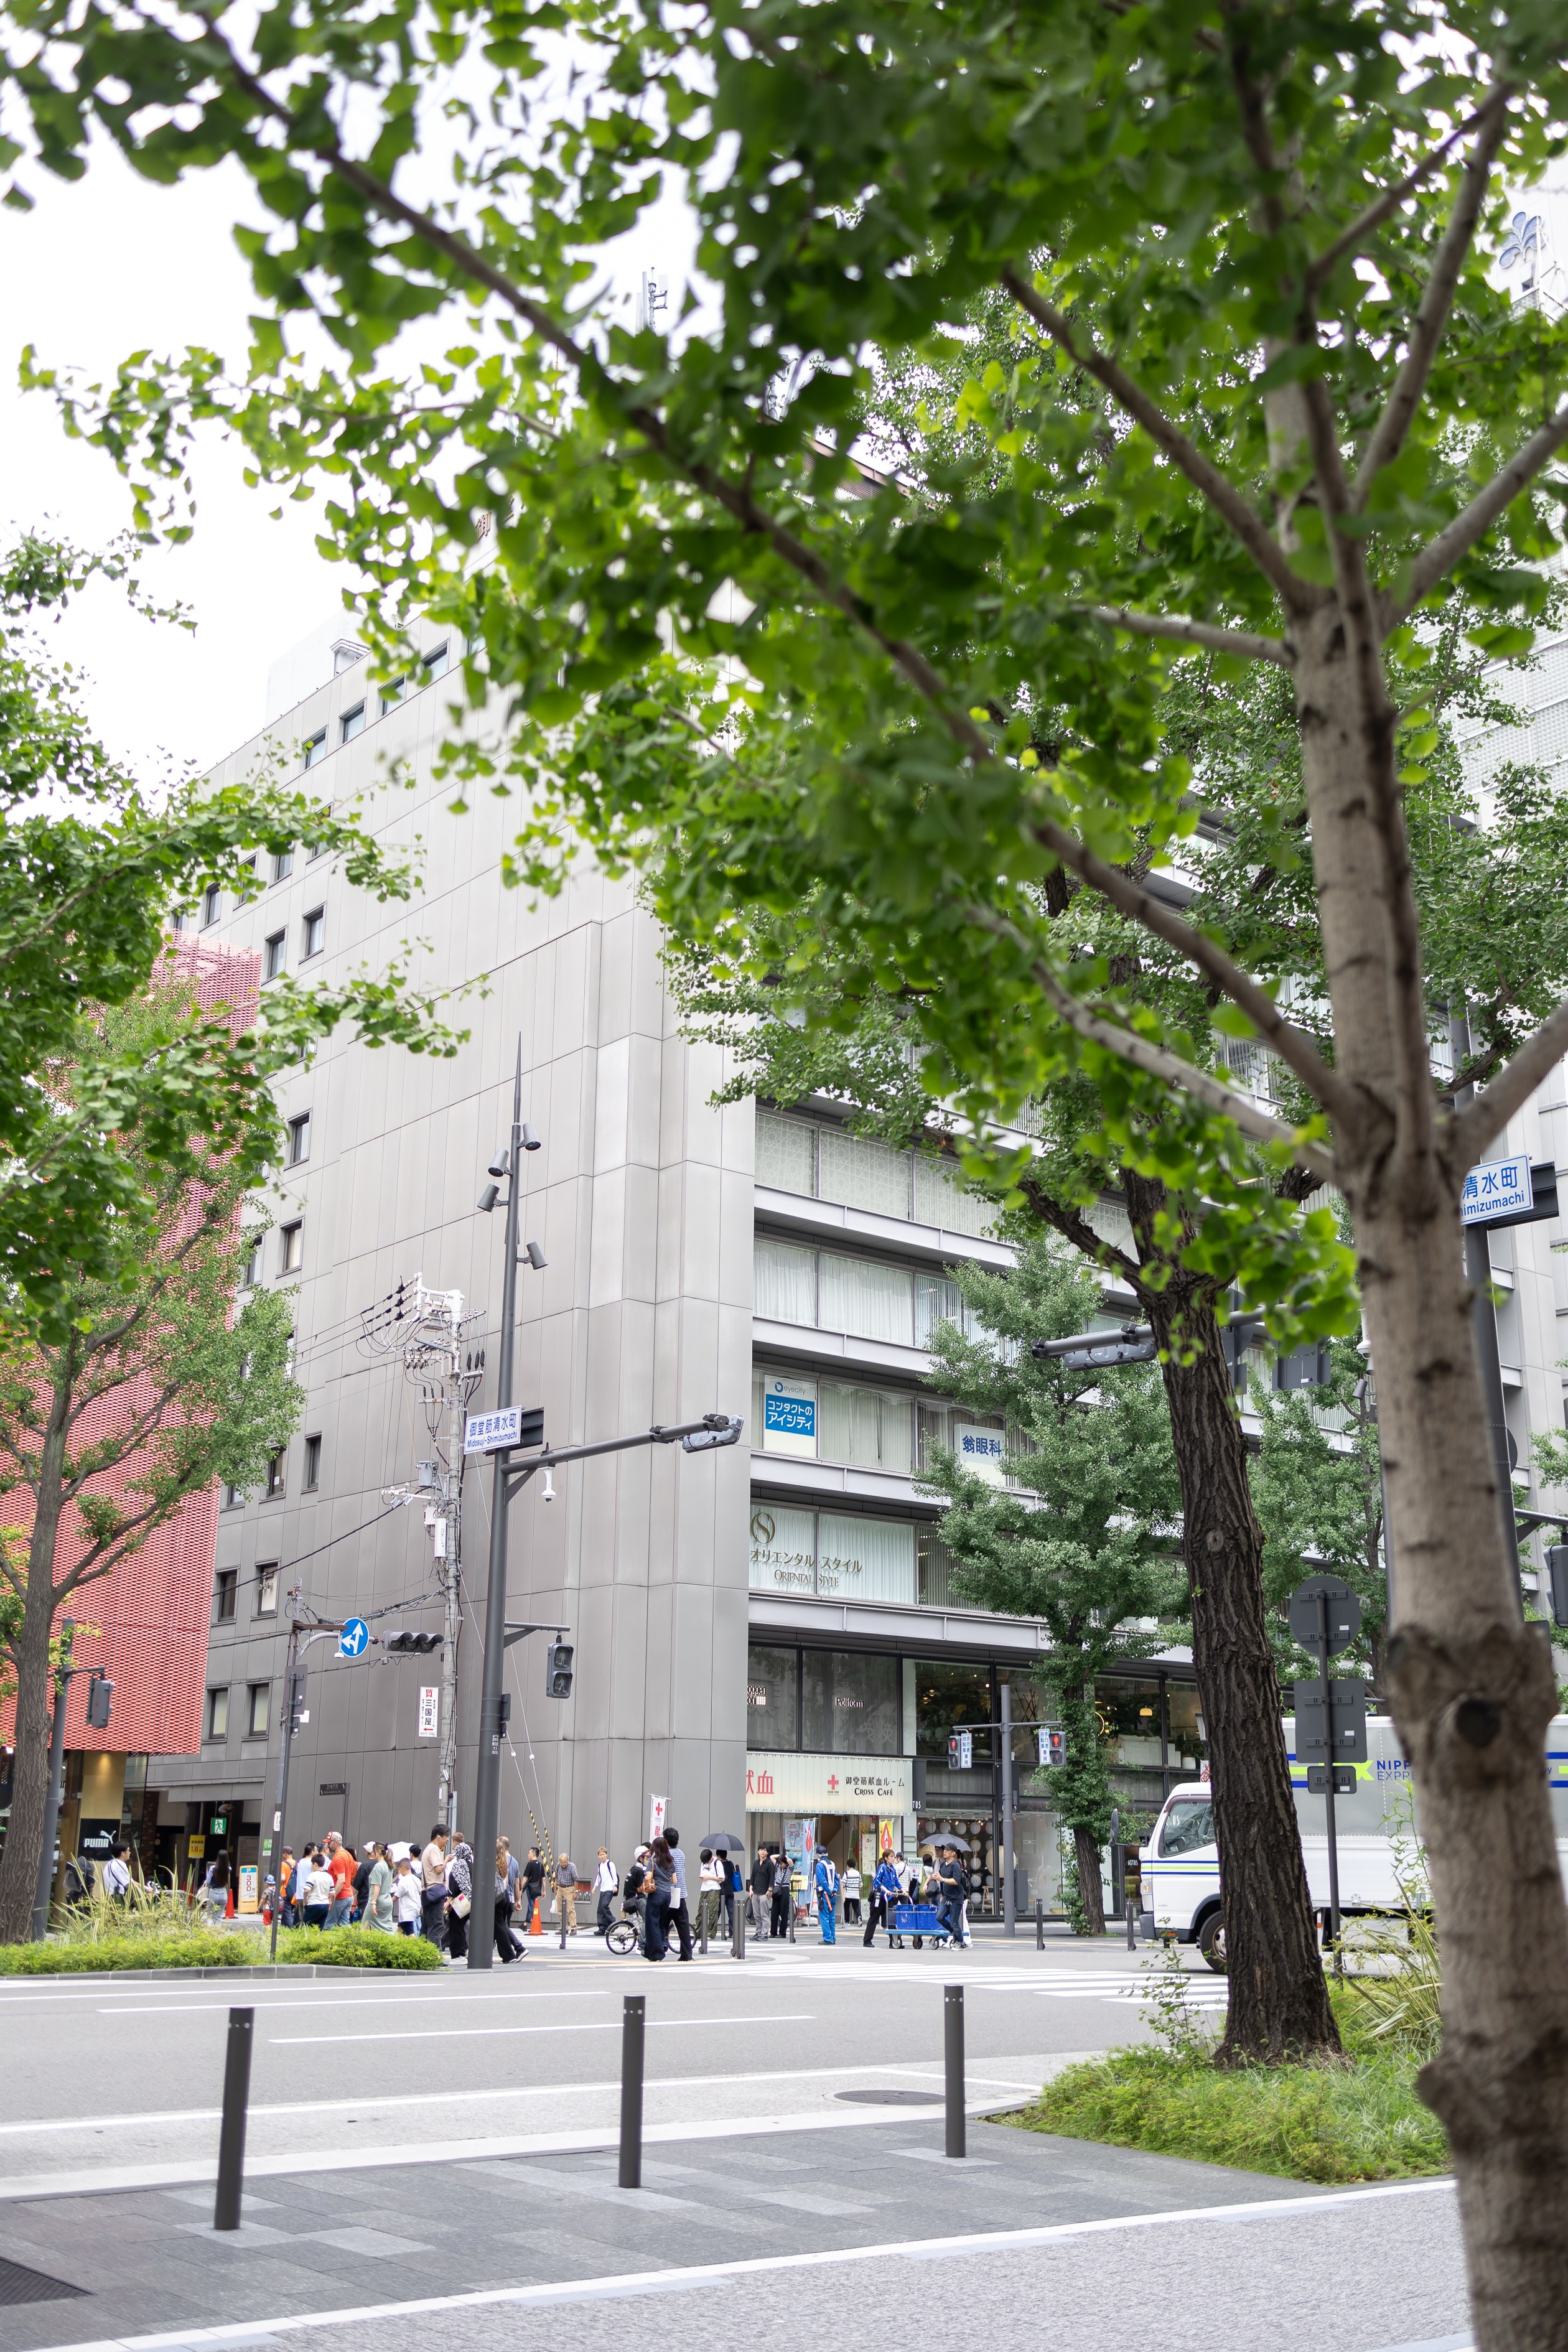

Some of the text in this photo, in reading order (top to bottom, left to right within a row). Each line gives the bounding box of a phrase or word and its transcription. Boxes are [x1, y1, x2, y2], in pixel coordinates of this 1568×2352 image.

[783, 1386, 806, 1396] eyecity
[768, 1400, 813, 1416] コンタクトの
[470, 1413, 516, 1437] 御堂筋清水町
[768, 1411, 812, 1430] アイシティ
[467, 1430, 517, 1448] Midosuji-Shimizumachi
[962, 1435, 1002, 1457] 翁眼科
[426, 1689, 433, 1697] 質
[835, 1697, 864, 1707] Poliform
[846, 1776, 905, 1786] 御堂筋献血ルーム
[84, 1838, 109, 1848] PUMA
